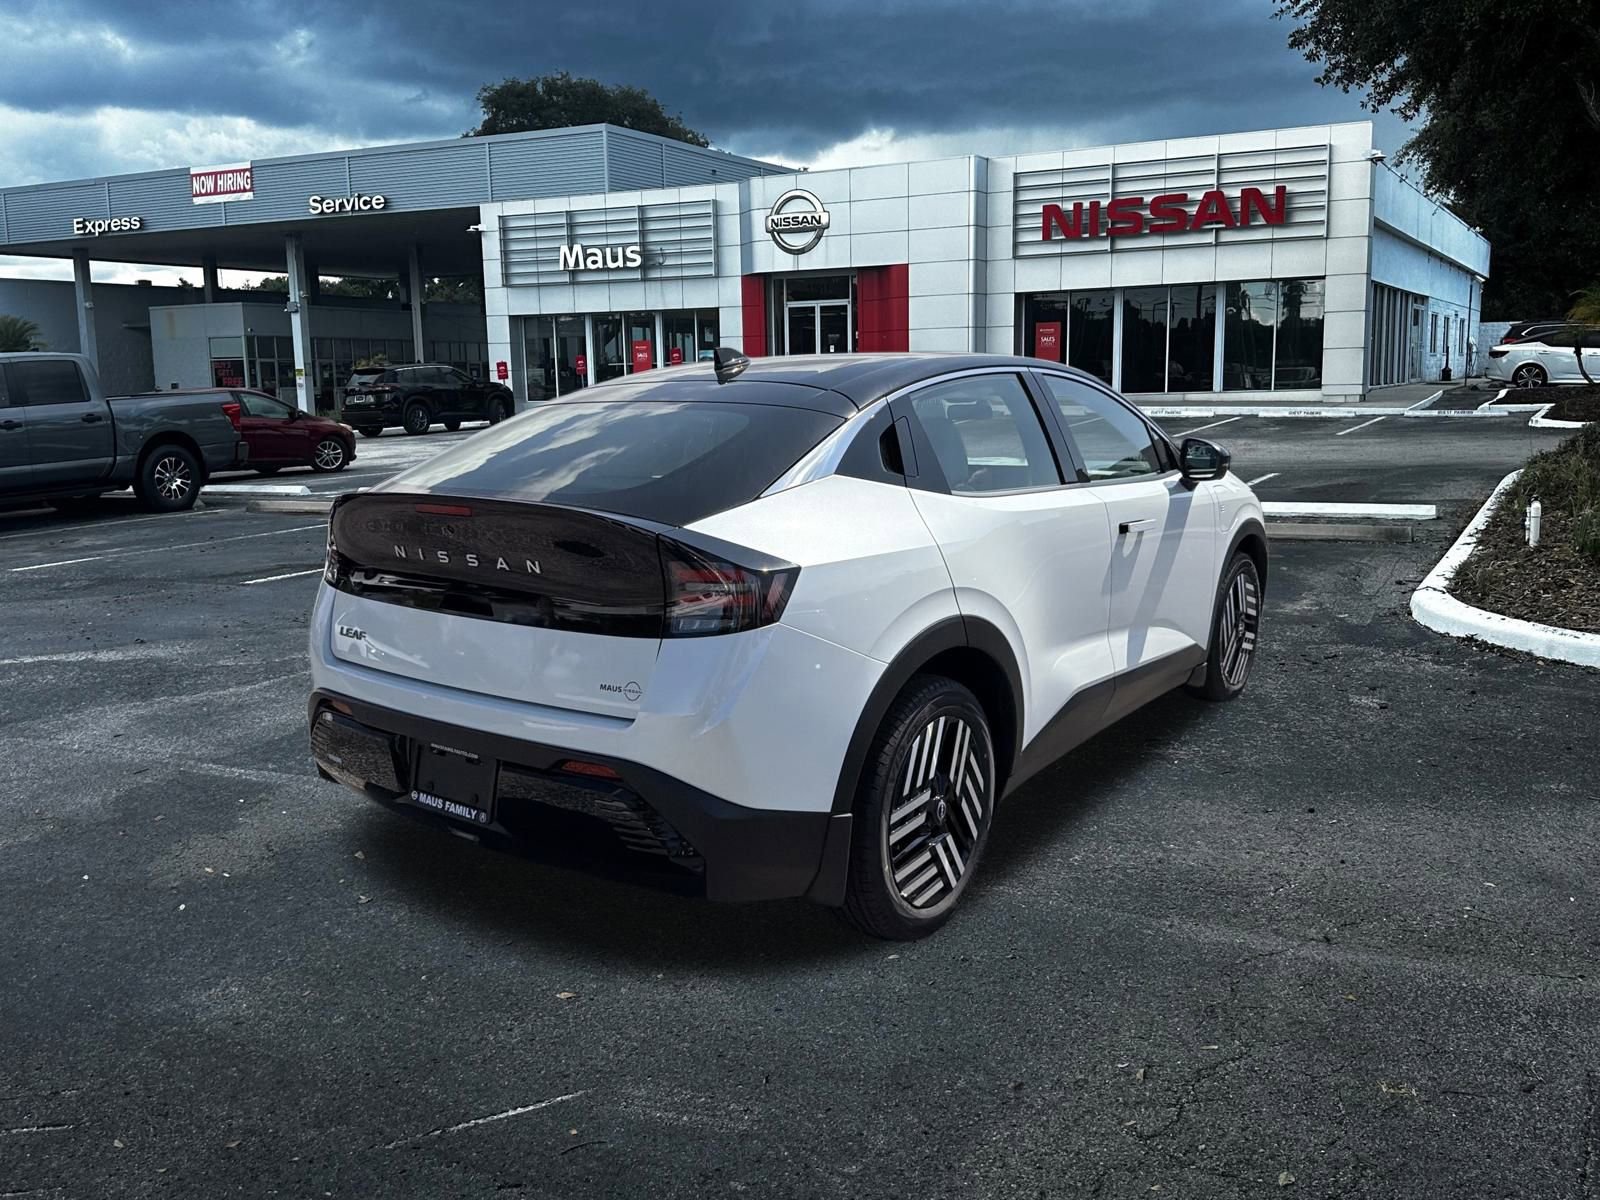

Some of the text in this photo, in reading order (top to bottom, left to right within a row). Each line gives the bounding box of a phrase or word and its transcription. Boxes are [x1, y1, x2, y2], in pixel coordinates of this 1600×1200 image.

[192, 171, 251, 195] NOW HIRING
[309, 193, 385, 214] Service
[1042, 185, 1287, 241] NISSAN
[73, 216, 141, 236] Express
[770, 214, 822, 230] NISSAN
[559, 244, 642, 271] Maus
[394, 544, 541, 574] NISSAN
[340, 626, 367, 640] LEAF
[600, 683, 622, 693] MAUS
[418, 792, 478, 820] MAUS FAMILY
